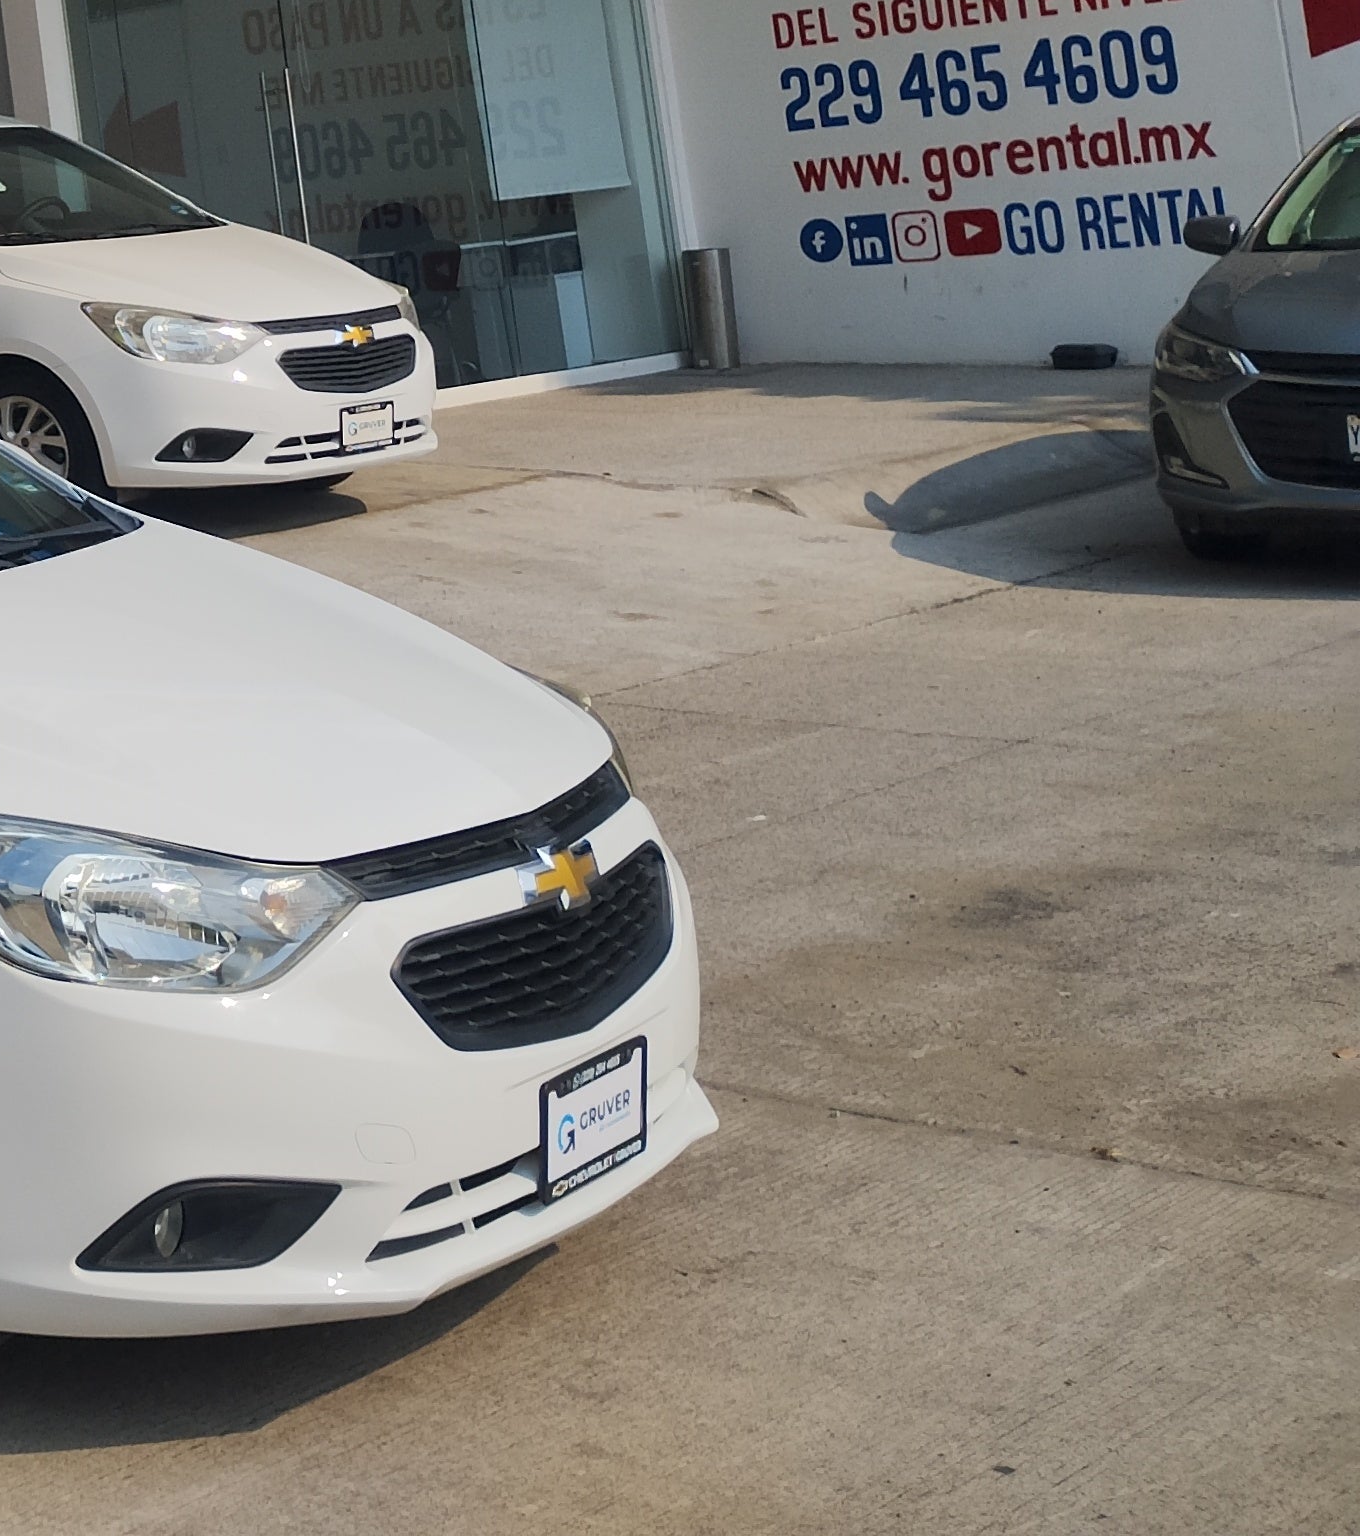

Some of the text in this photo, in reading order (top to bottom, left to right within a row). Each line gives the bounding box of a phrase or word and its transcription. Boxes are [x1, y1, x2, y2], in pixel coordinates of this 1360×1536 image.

[772, 7, 839, 49] DEL
[779, 24, 1179, 133] 229 465 4609
[923, 117, 1218, 202] gorental.mx
[1003, 199, 1065, 255] GO
[579, 1089, 631, 1131] GRUVER
